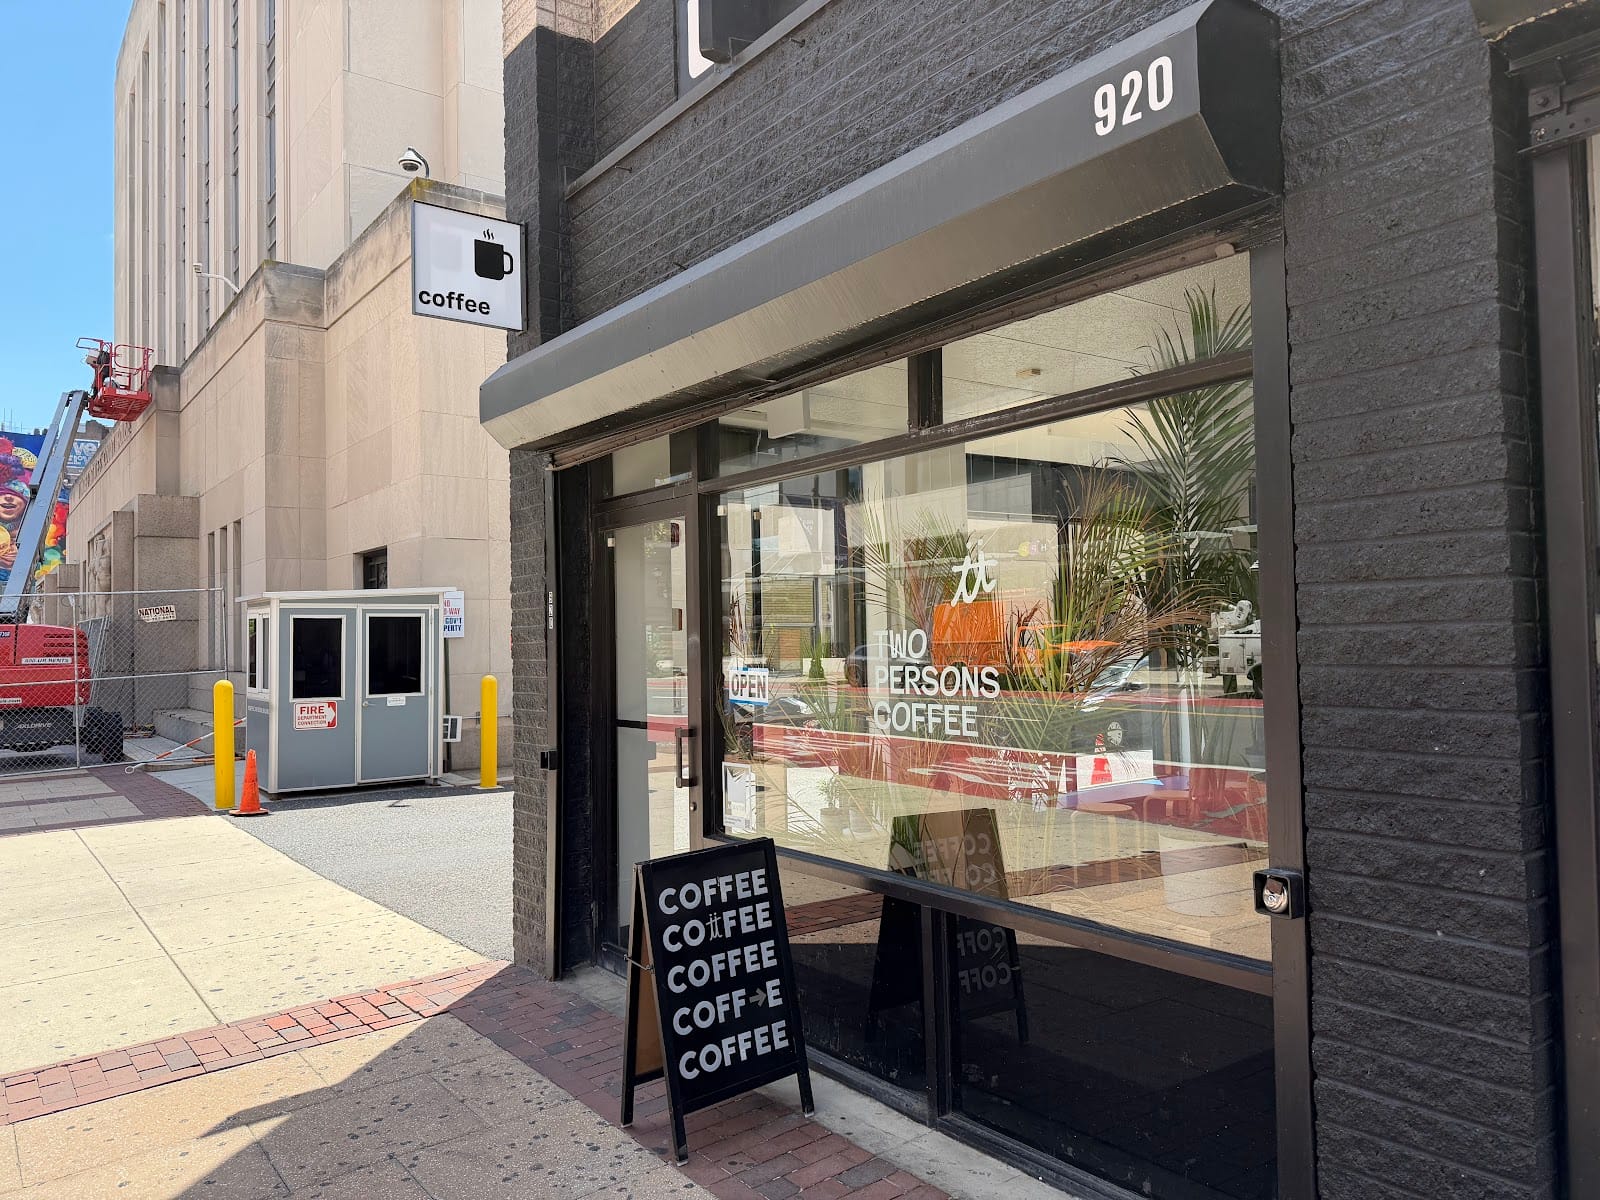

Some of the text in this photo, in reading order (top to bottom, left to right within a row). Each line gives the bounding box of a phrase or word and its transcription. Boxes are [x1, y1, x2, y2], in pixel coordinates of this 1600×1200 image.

[1094, 55, 1173, 136] 920
[418, 290, 491, 316] coffee
[138, 606, 175, 616] NATIONAL
[872, 628, 928, 662] TWO
[731, 674, 767, 699] OPEN
[875, 665, 1001, 699] PERSONS
[299, 705, 325, 715] FIRE
[873, 700, 979, 738] COFFEE
[658, 868, 769, 915] COFFEE
[667, 939, 778, 994] COFFEE
[679, 1019, 790, 1080] COFFEE
